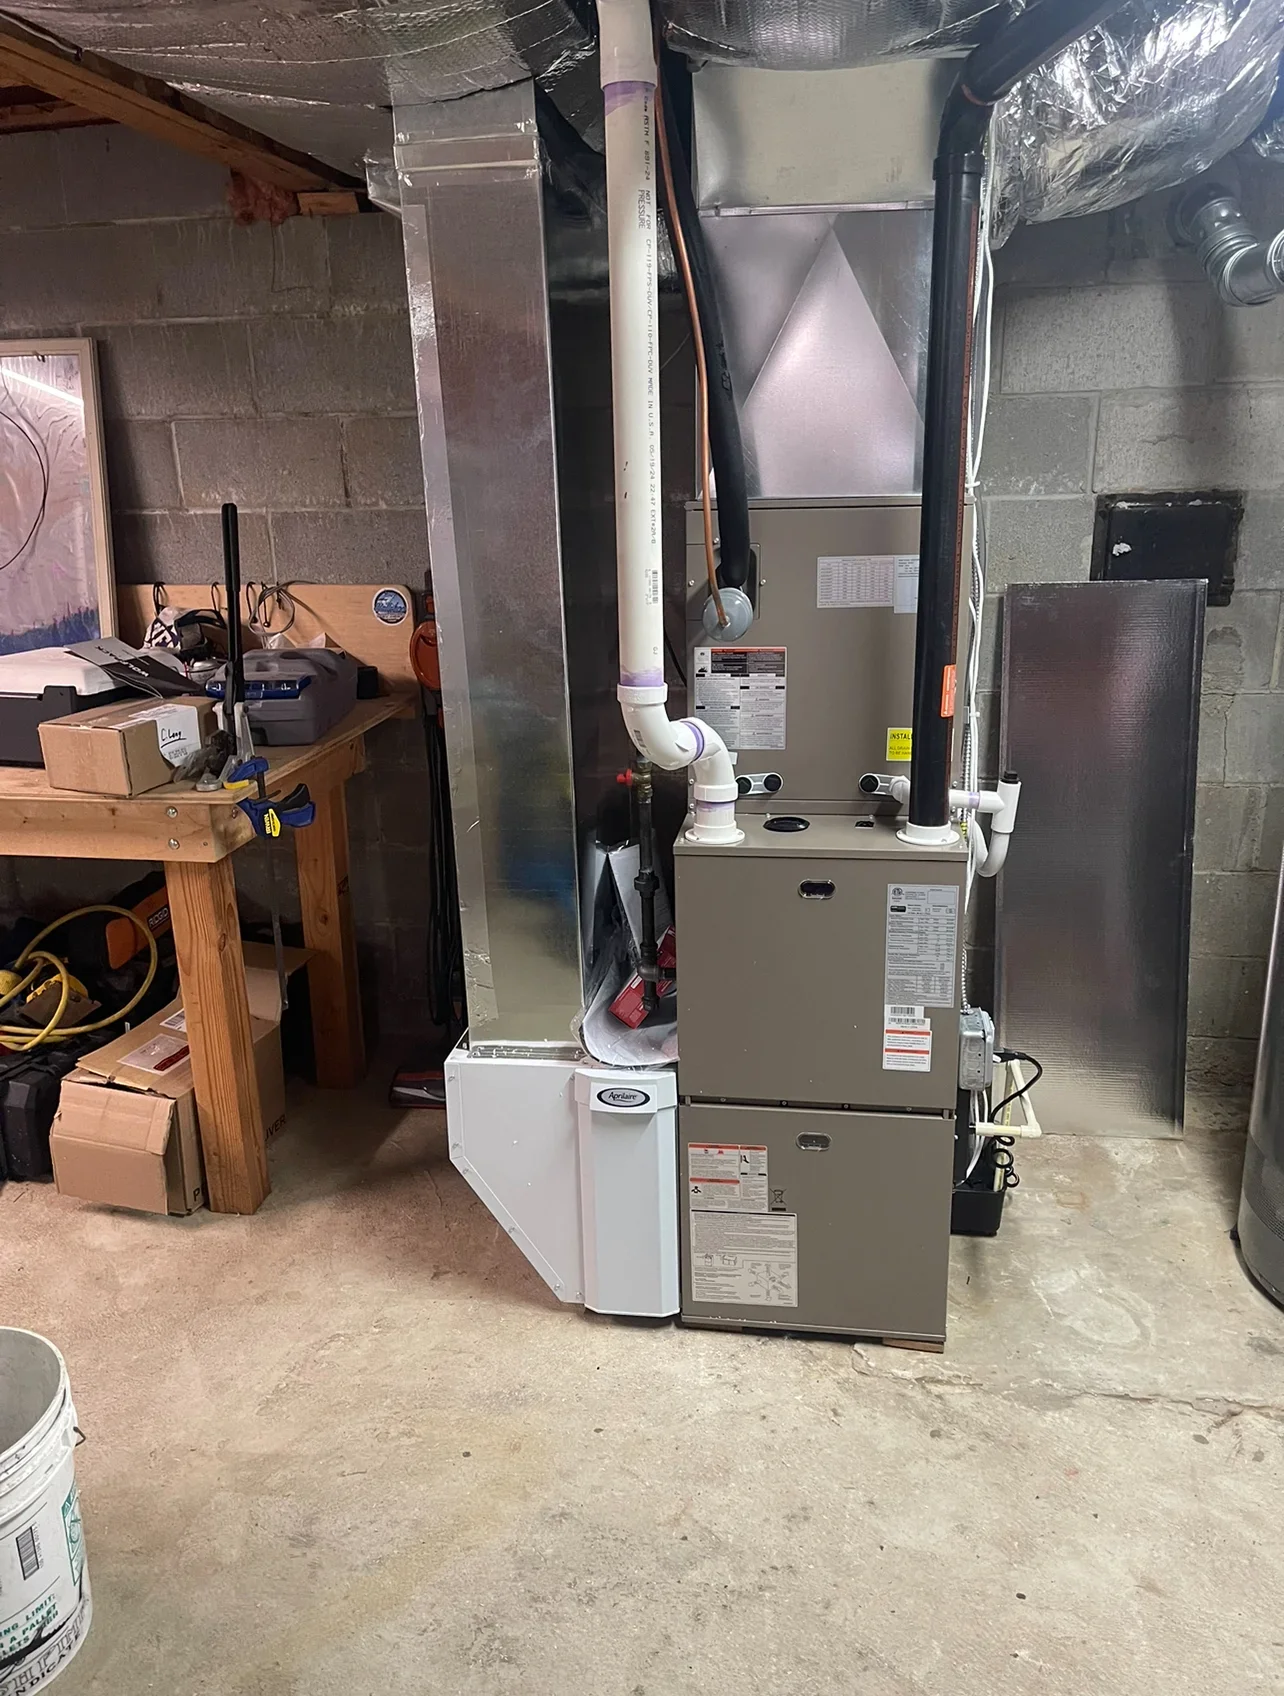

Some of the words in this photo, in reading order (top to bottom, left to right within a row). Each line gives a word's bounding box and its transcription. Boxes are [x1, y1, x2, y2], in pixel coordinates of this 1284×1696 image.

[648, 400, 654, 409] IN
[148, 907, 169, 928] RIDGID
[22, 1601, 57, 1636] PALLET
[26, 1593, 56, 1621] LIMIT:
[9, 1631, 81, 1696] NDICATE
